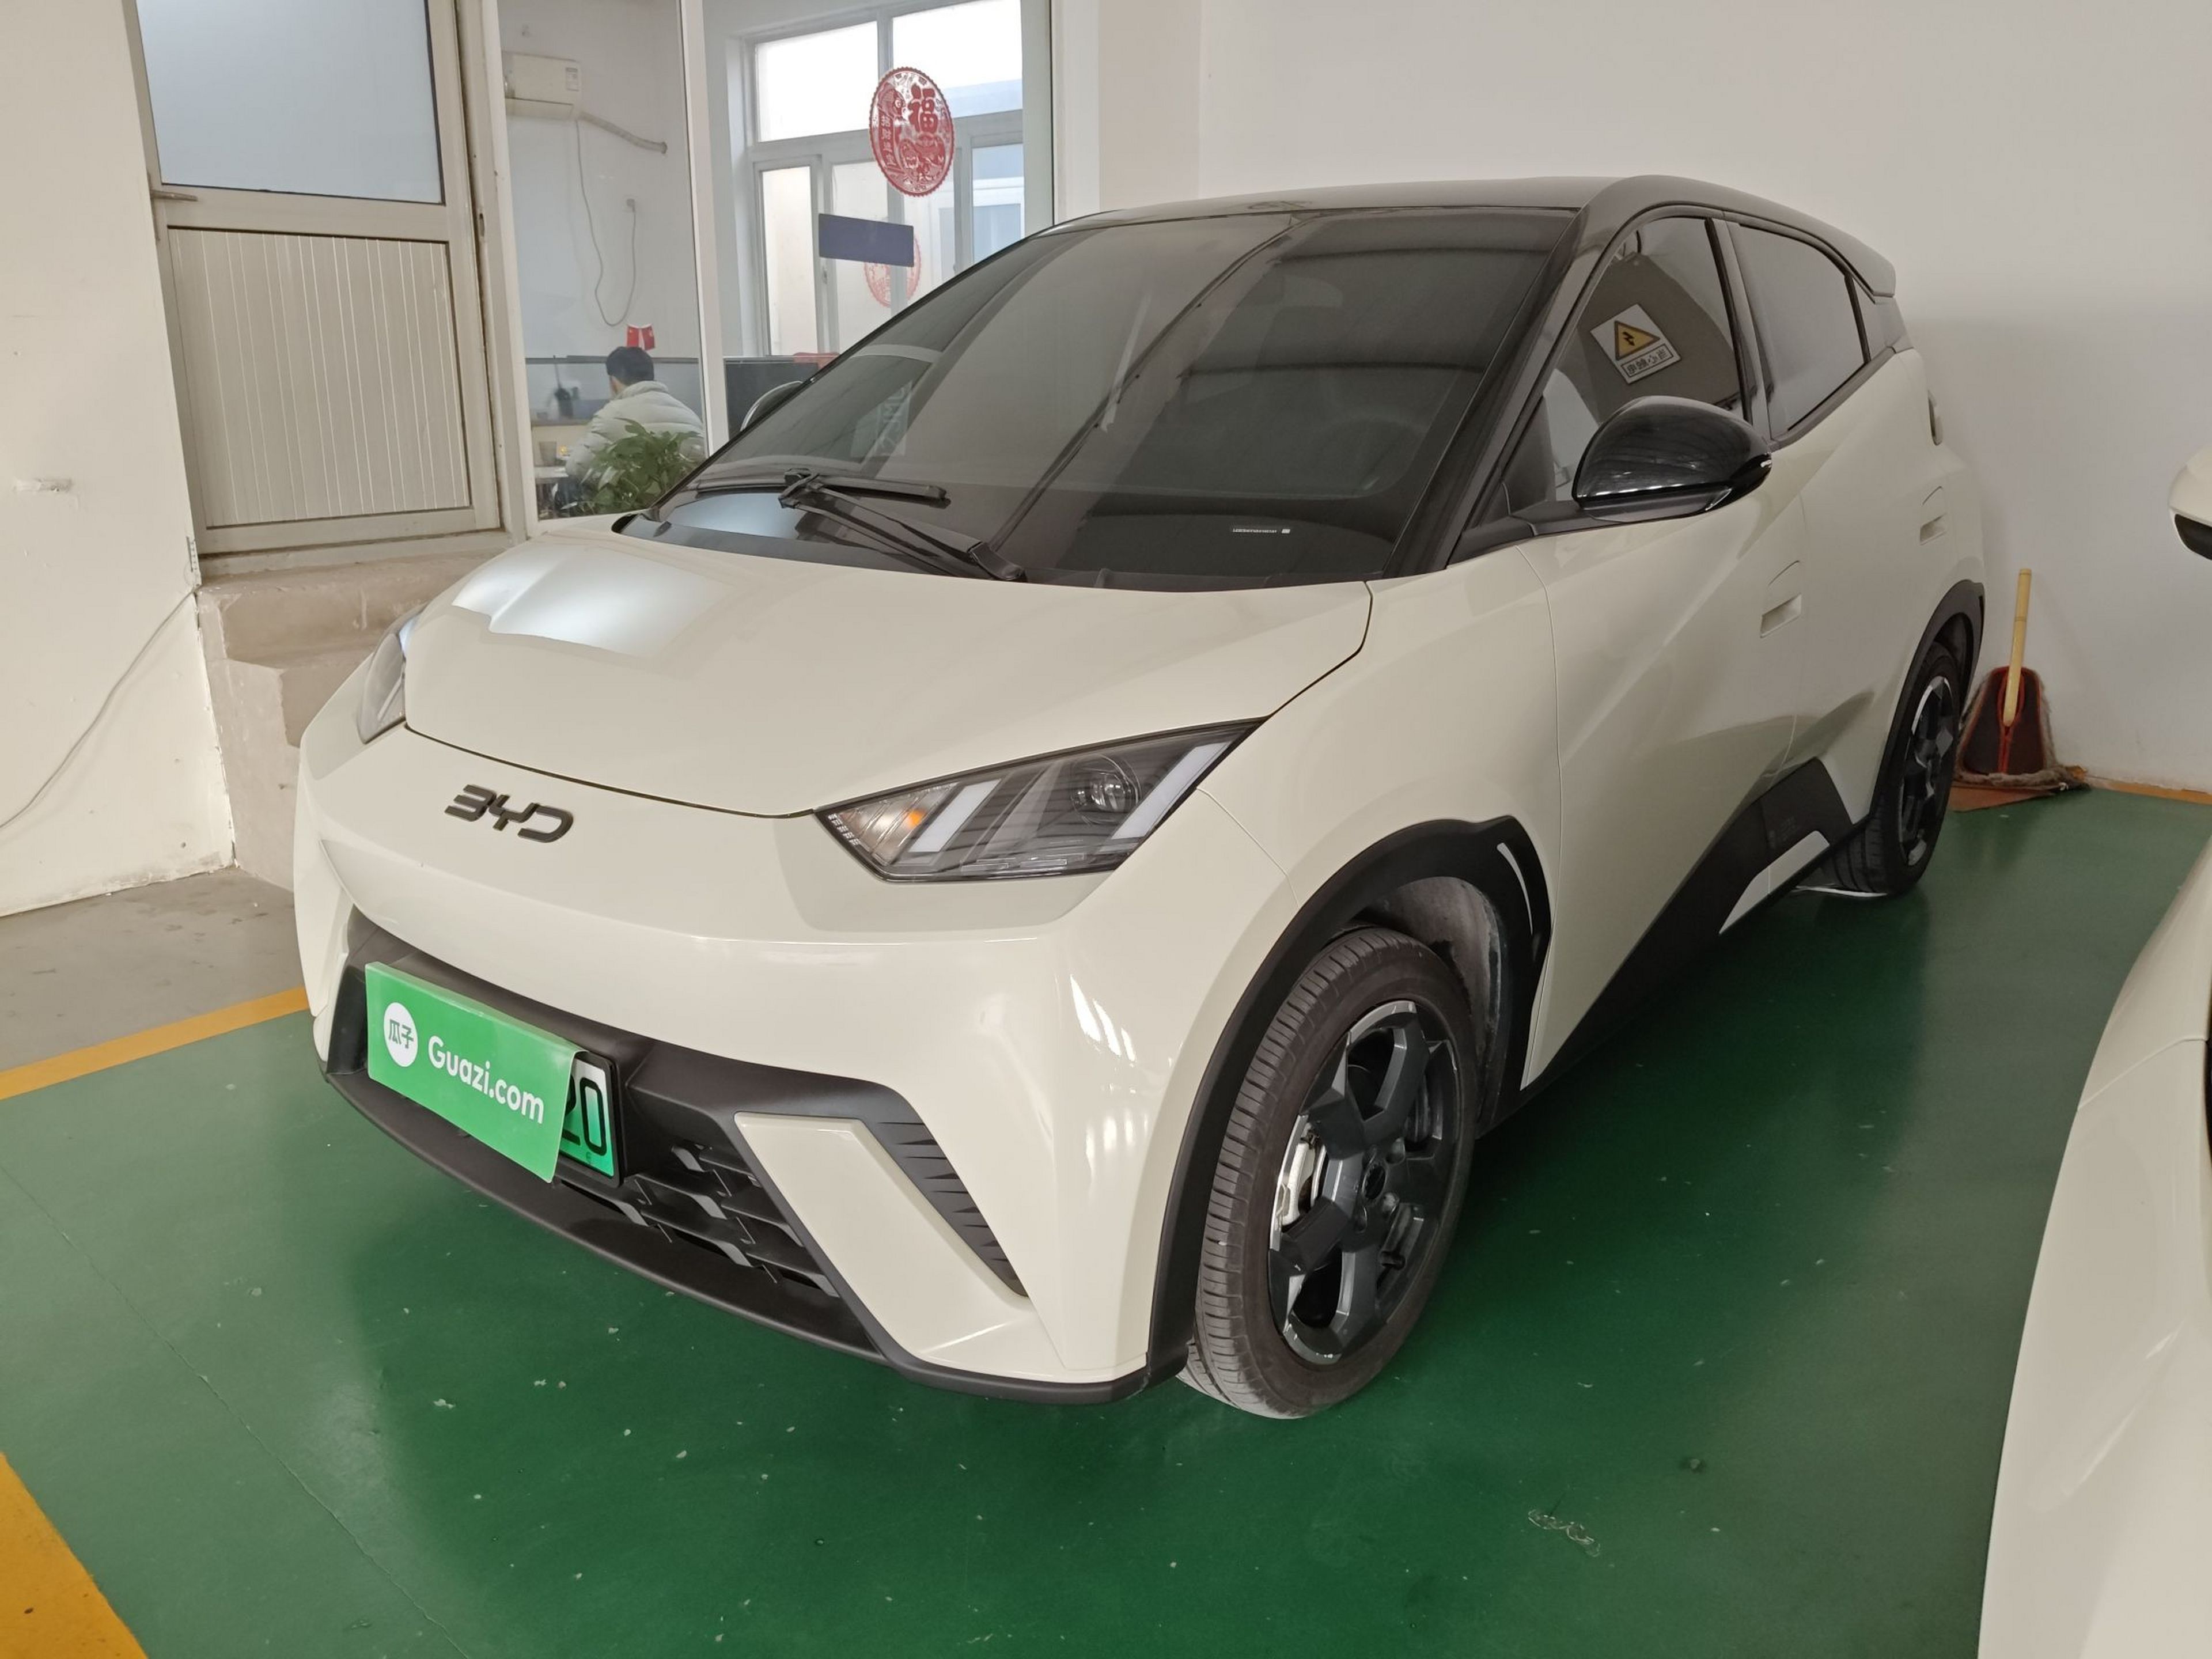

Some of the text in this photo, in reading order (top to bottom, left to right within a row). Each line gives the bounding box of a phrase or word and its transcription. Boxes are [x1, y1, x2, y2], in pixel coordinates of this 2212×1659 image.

[908, 84, 939, 134] 福
[444, 784, 574, 843] BYD
[388, 1018, 414, 1050] 瓜子
[427, 1035, 545, 1125] Guazi.com
